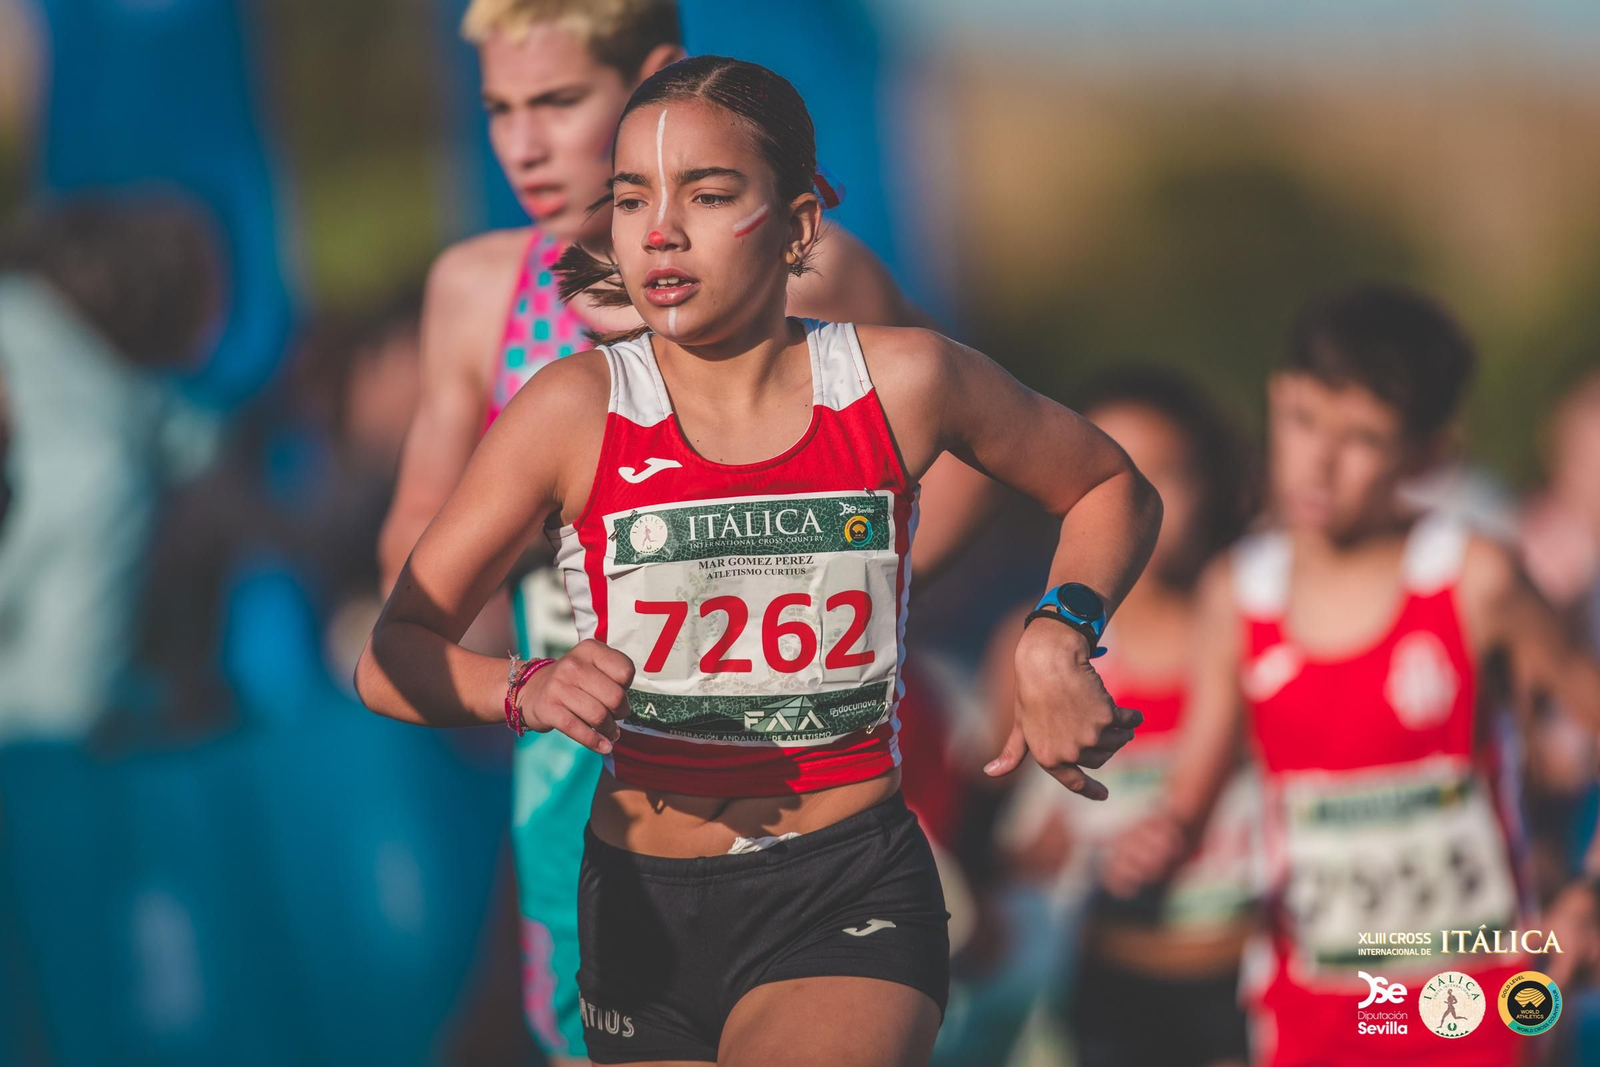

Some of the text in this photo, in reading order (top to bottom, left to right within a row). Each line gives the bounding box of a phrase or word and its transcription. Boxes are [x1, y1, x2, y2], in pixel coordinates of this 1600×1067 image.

[687, 505, 824, 541] ITÁLICA
[690, 535, 824, 549] INTERNATIONAL CROSS COUNTRY
[698, 555, 814, 570] MAR GOMEZ PEREZ
[706, 567, 806, 580] ATLETISMO CURTIUS
[634, 589, 876, 674] 7262
[838, 699, 877, 714] docunova
[669, 729, 719, 741] FEDERACIÓN
[722, 734, 768, 742] ANDALUZA
[786, 731, 832, 741] ATLETISMO
